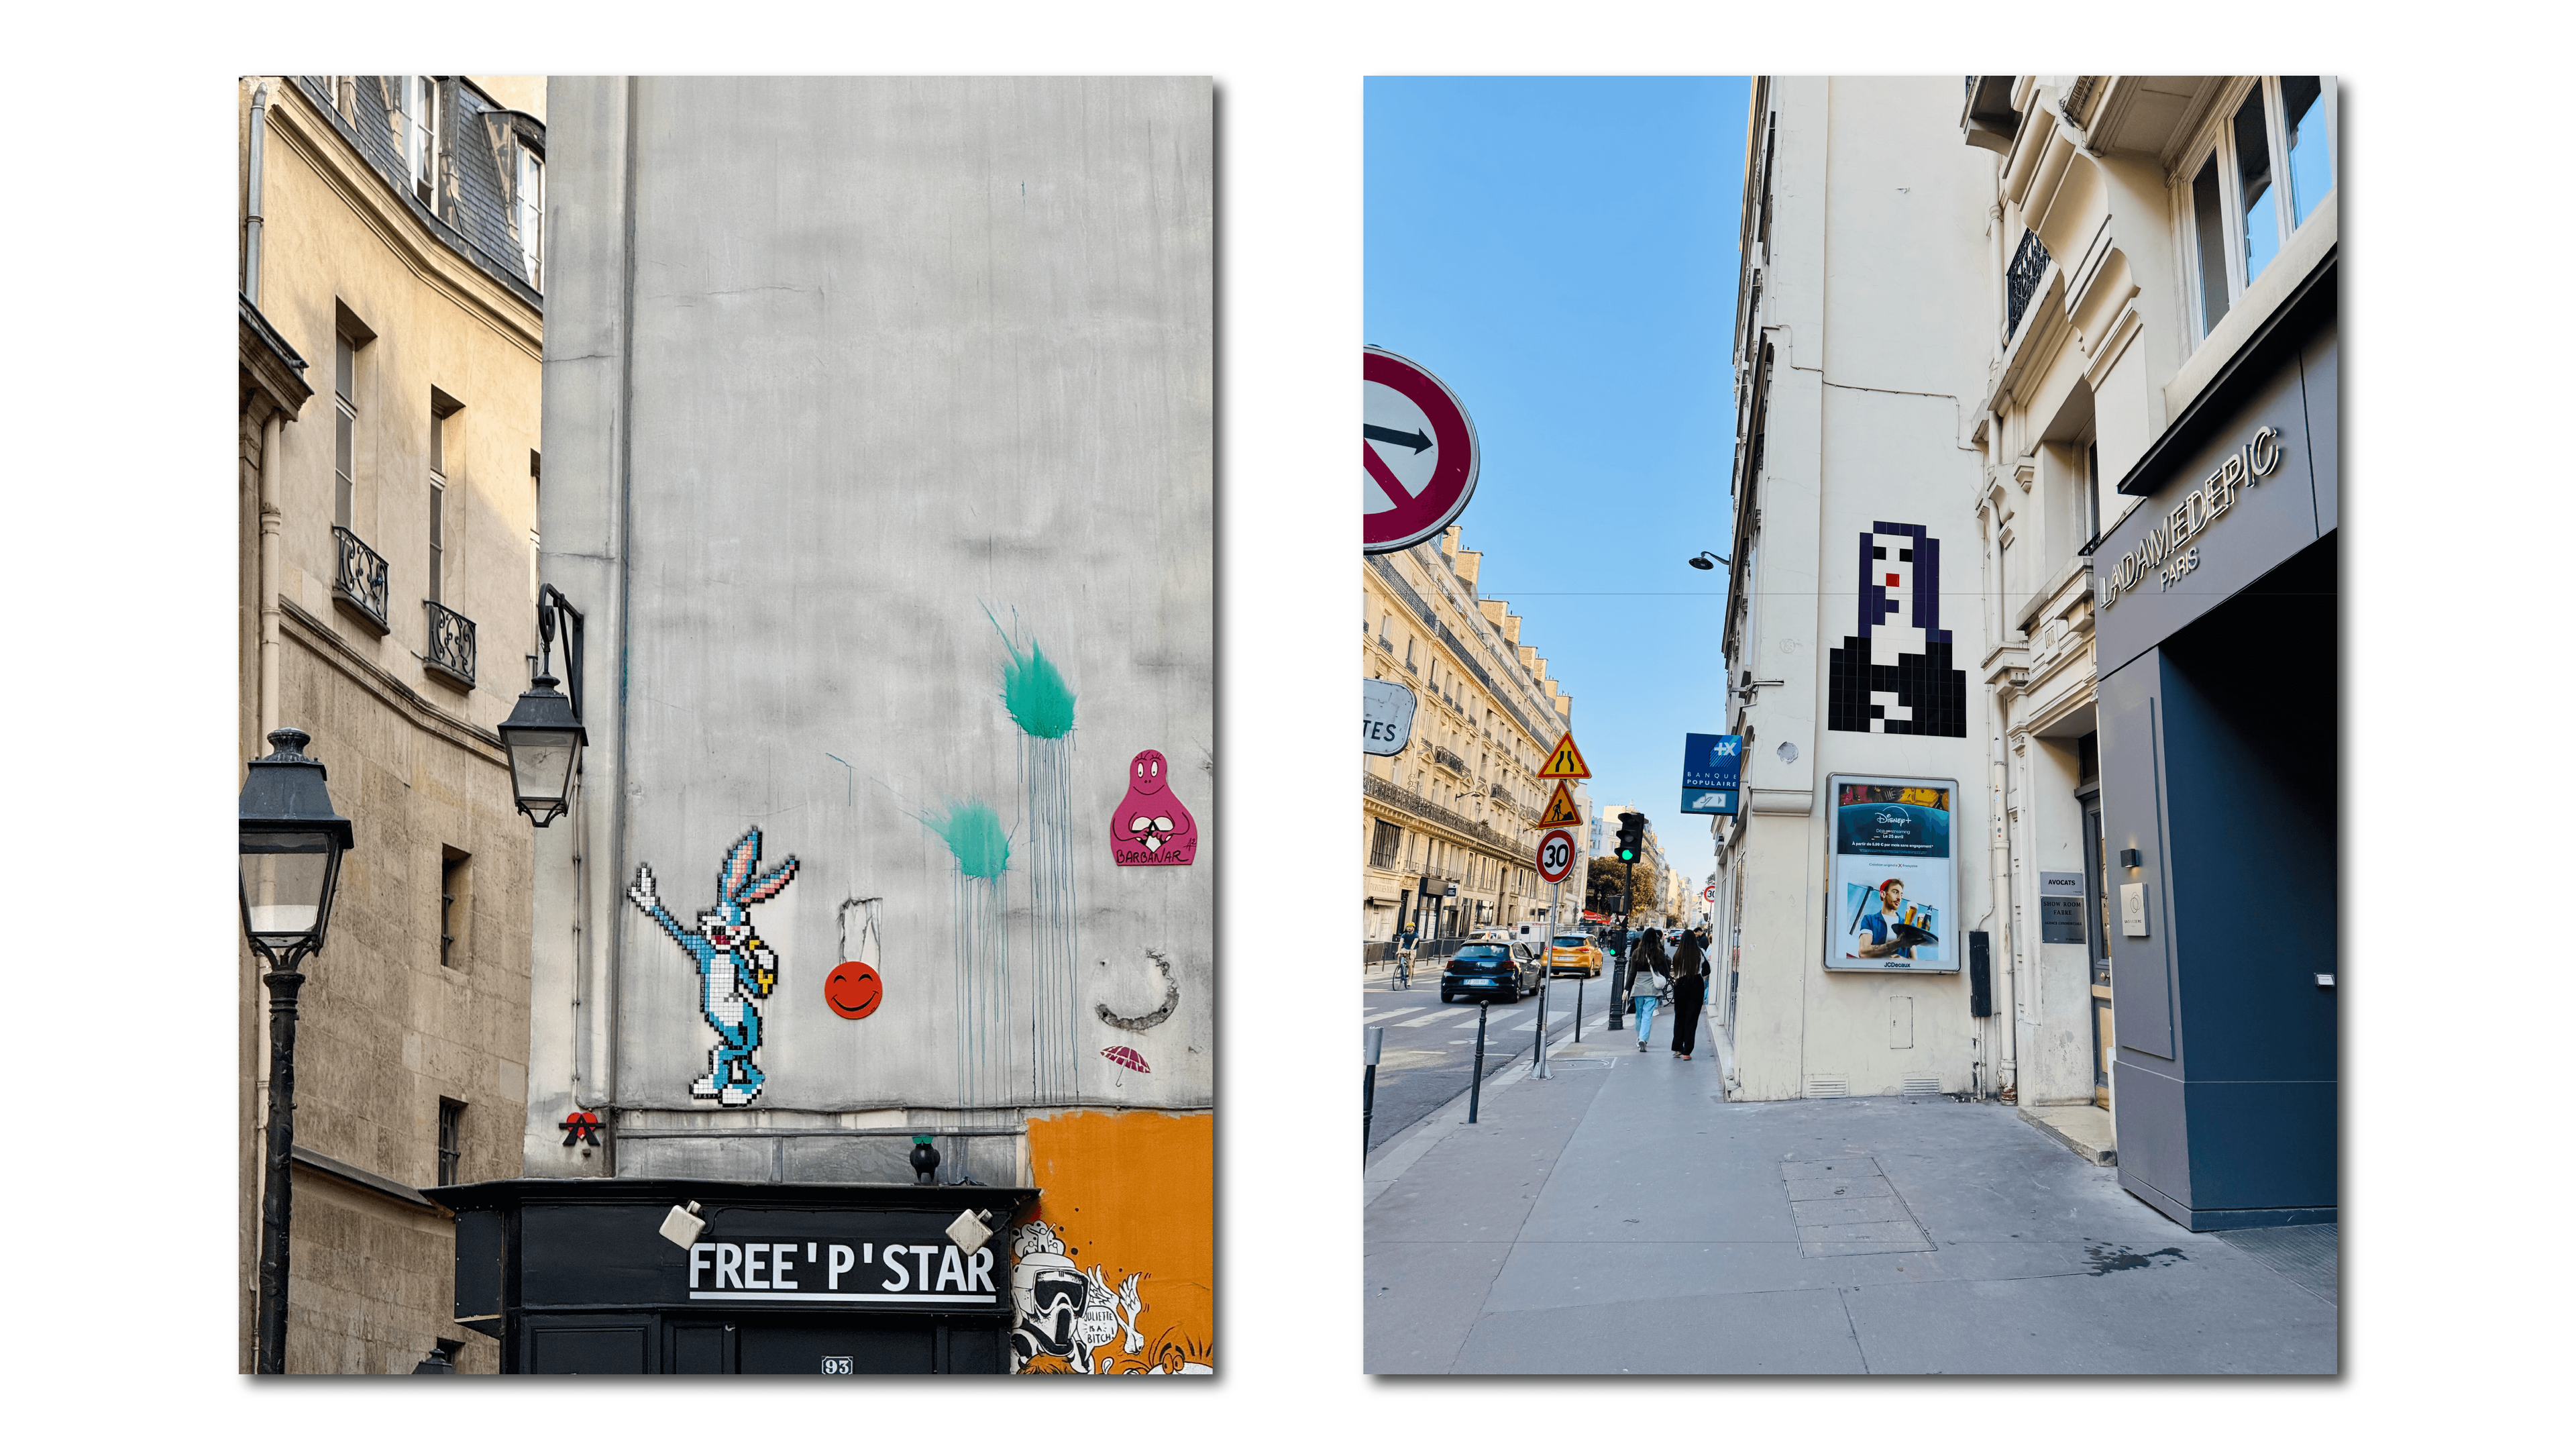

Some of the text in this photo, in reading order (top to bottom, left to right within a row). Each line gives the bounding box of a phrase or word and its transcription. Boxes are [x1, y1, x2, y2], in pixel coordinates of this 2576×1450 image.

[2160, 547, 2200, 592] PARIS
[1686, 779, 1736, 787] POPULAIRE
[1687, 772, 1737, 780] BANQUE
[1116, 848, 1189, 864] BARBANAR
[1544, 844, 1568, 868] 30
[690, 1242, 996, 1292] FREE'P'STAR
[1084, 1311, 1113, 1321] JULIETTE
[1087, 1327, 1114, 1344] BITCH!
[825, 1359, 849, 1374] 93
